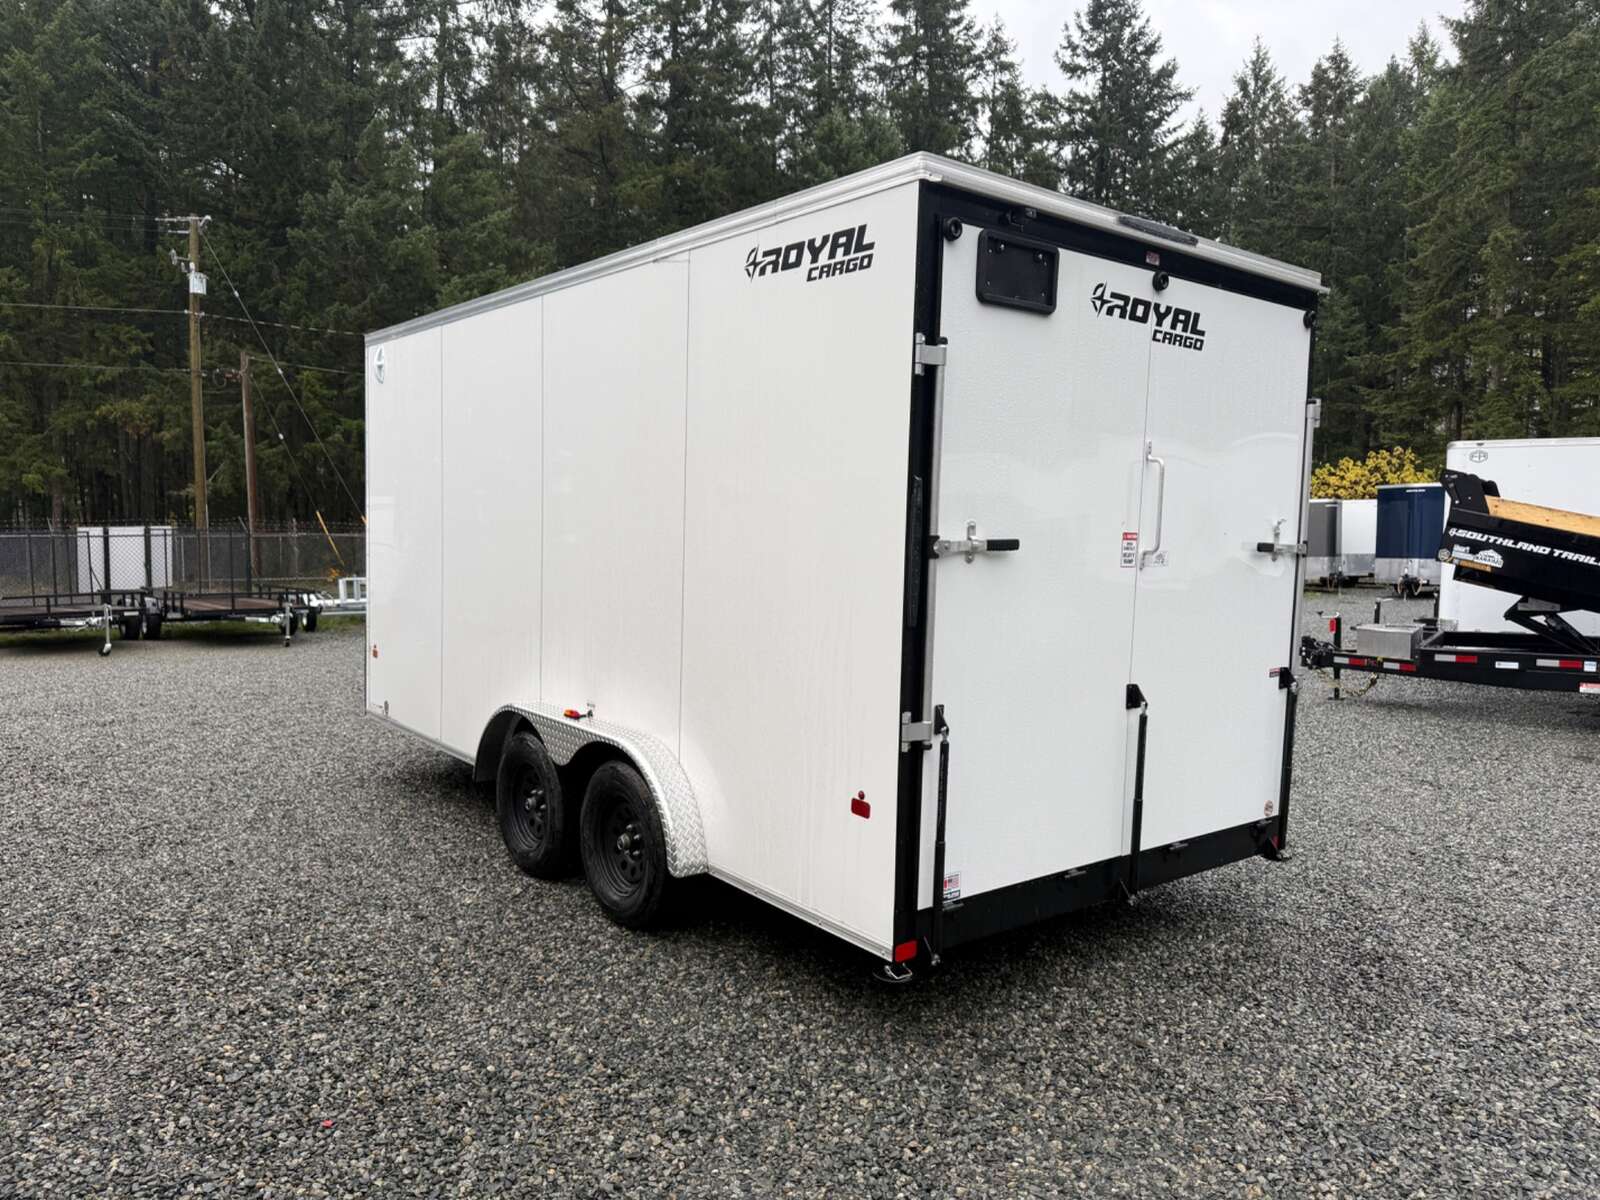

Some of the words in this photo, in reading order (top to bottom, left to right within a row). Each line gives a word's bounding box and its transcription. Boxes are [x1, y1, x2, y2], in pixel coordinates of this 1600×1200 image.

[758, 223, 875, 277] ROYAL
[806, 253, 874, 282] CARGO
[1105, 291, 1206, 337] ROYAL
[1151, 328, 1205, 352] CARGO
[1455, 529, 1552, 555] SOUTHLAND
[1553, 548, 1600, 567] TRAIL
